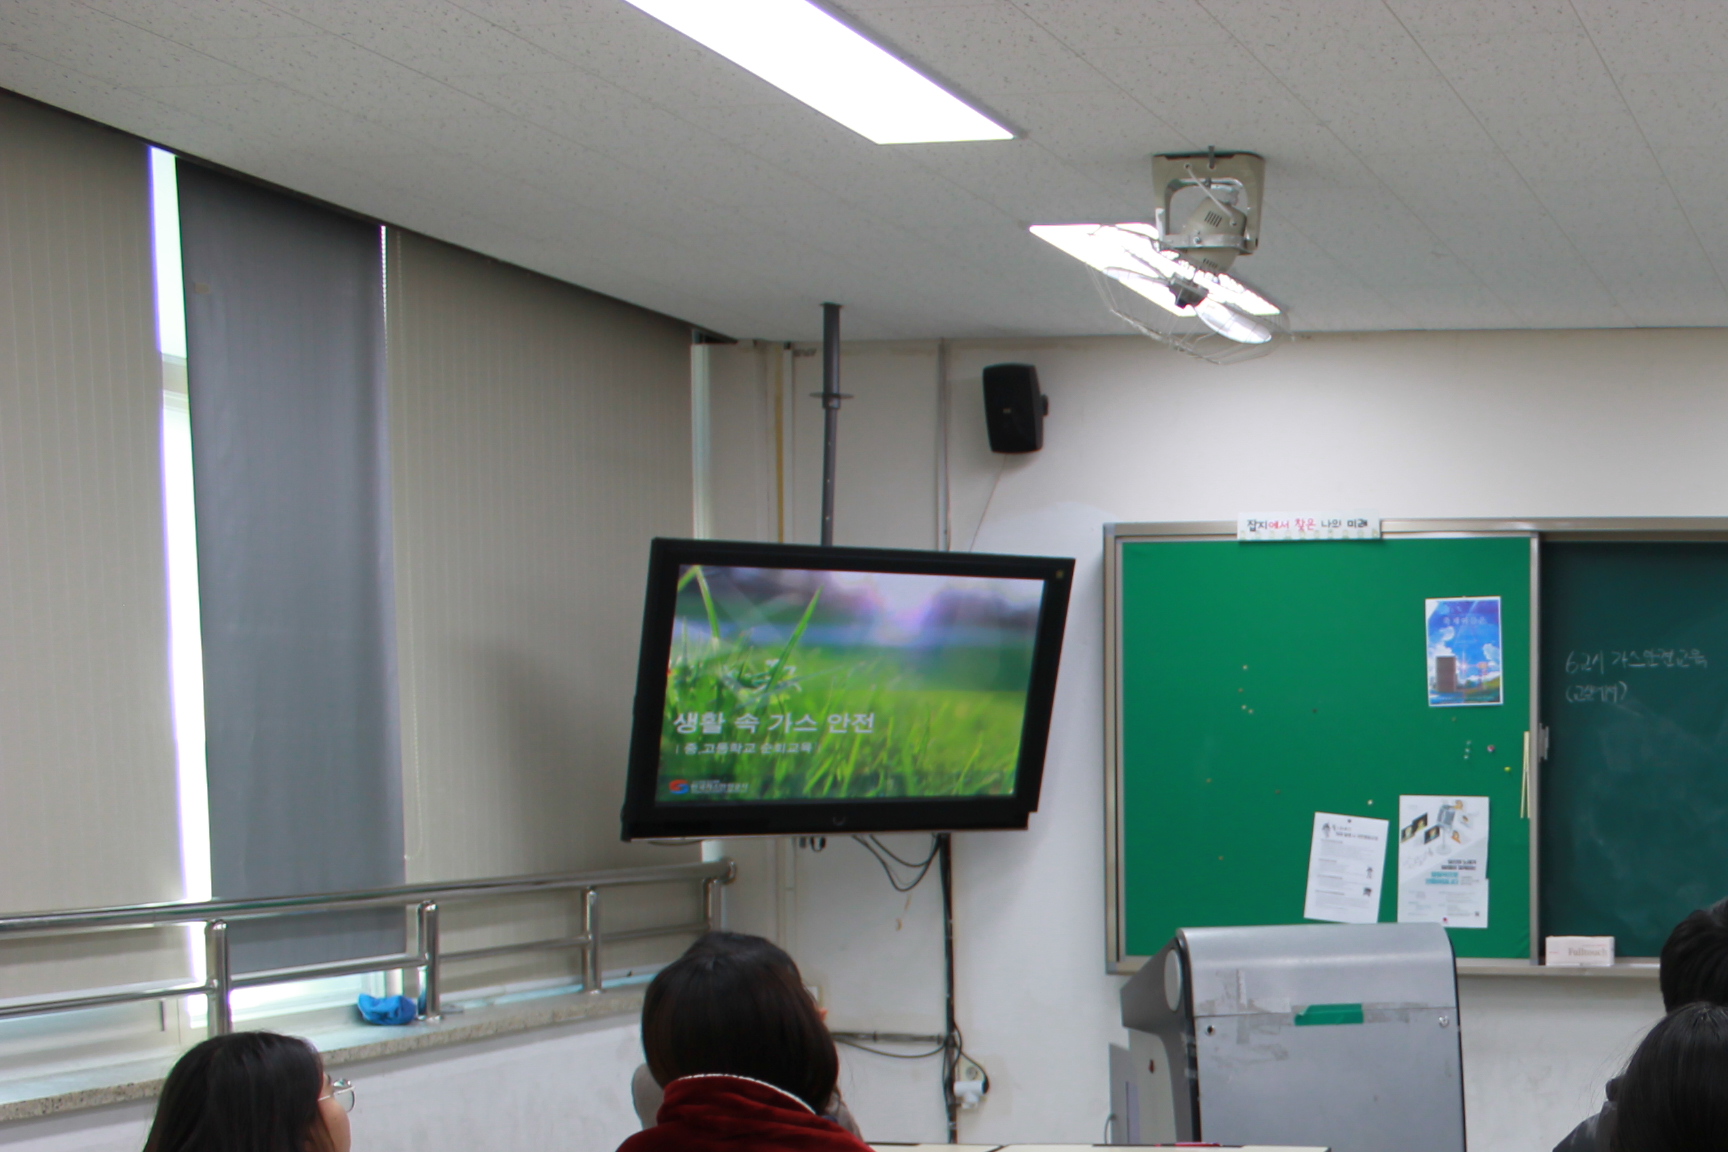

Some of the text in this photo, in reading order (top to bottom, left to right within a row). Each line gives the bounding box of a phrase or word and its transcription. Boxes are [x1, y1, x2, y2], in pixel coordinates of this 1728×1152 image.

[1295, 518, 1316, 532] 찾은
[1321, 518, 1342, 528] 나의
[1347, 518, 1368, 528] 미래
[674, 712, 875, 734] 생활 속 가스 안전
